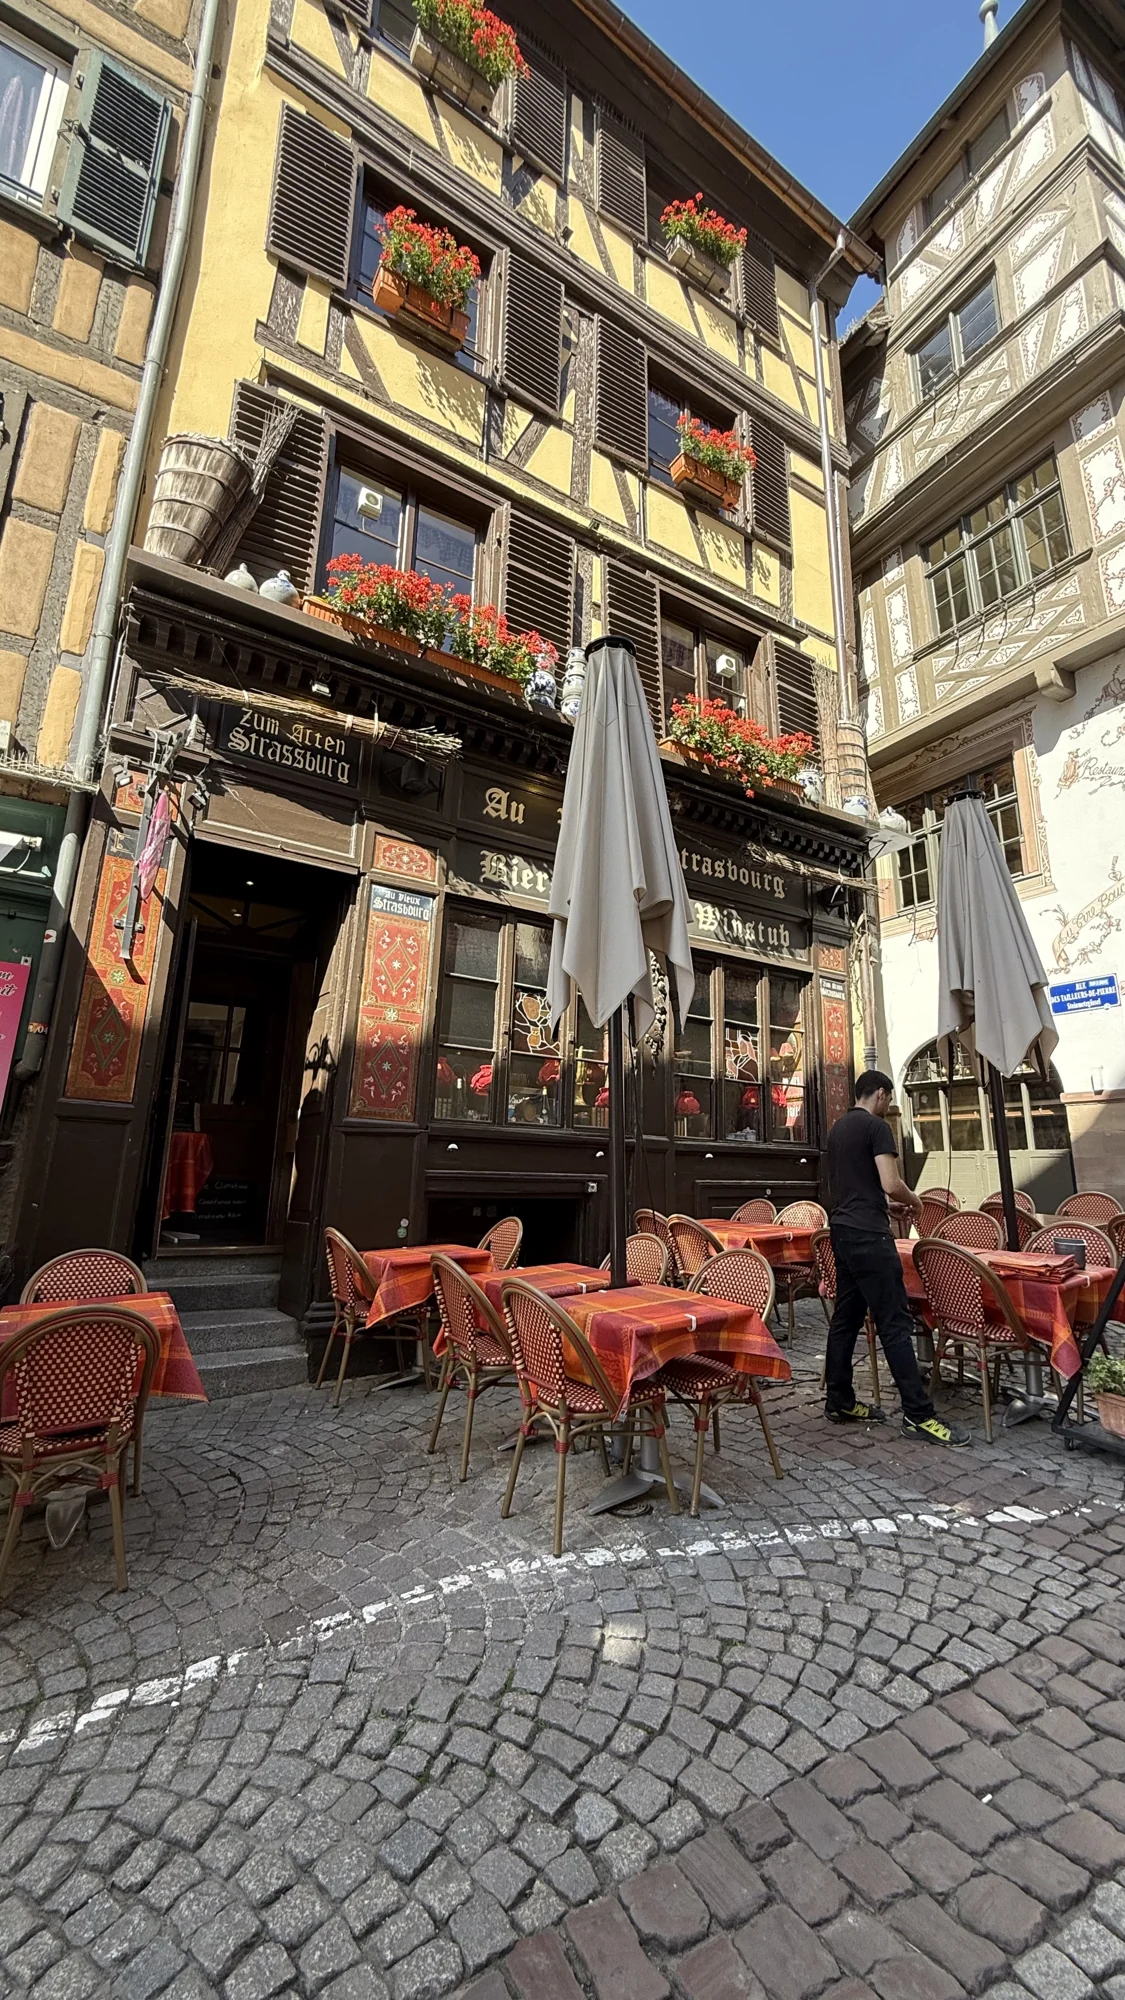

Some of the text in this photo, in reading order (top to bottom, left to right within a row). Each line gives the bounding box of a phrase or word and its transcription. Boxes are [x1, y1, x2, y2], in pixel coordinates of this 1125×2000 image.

[240, 707, 279, 735] Zum
[228, 726, 350, 784] Strassburg
[483, 787, 525, 825] Au
[480, 850, 553, 893] Bier
[680, 847, 786, 899] trasbourg
[373, 896, 430, 921] Strasbourg
[694, 902, 790, 948] Winstub
[1061, 985, 1117, 1002] TAILLEURS-DE-PIERRE
